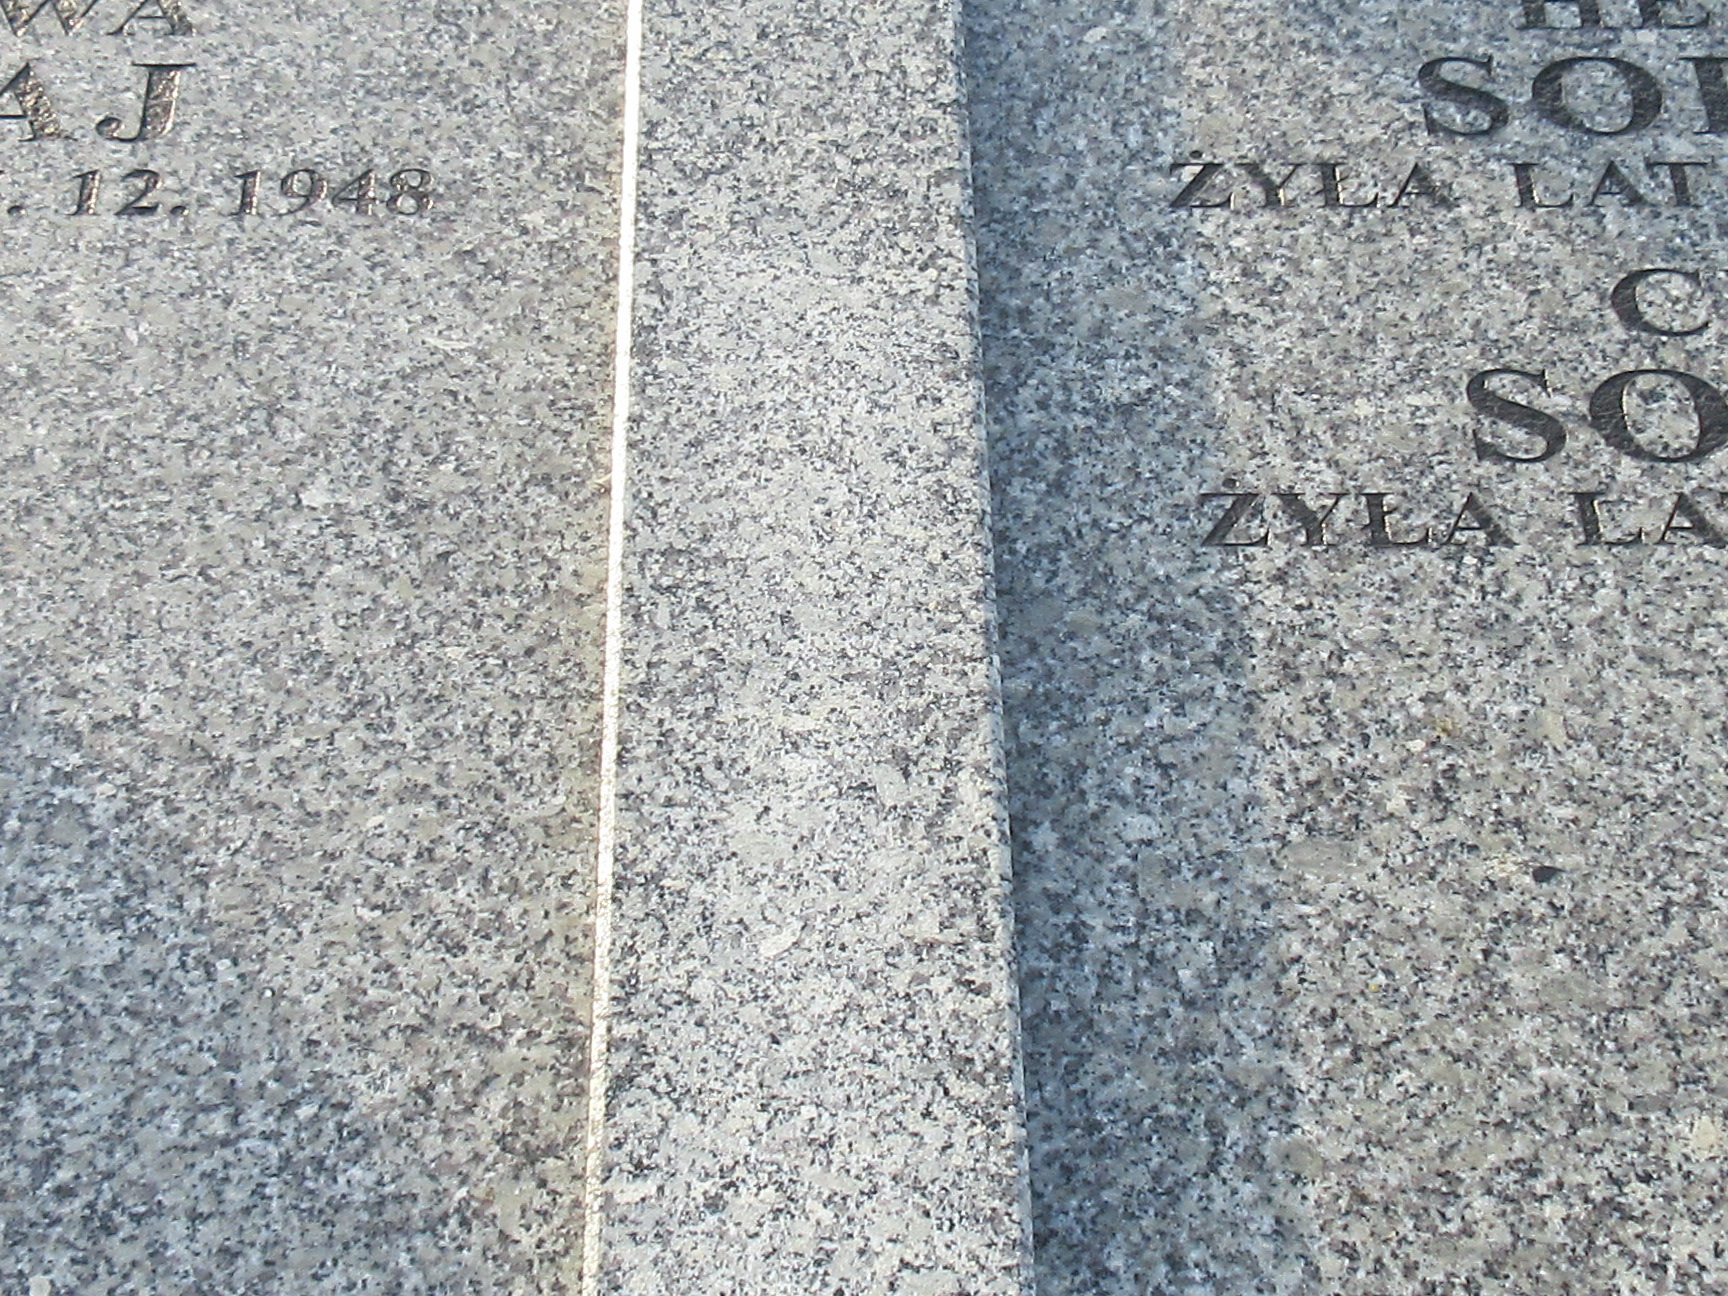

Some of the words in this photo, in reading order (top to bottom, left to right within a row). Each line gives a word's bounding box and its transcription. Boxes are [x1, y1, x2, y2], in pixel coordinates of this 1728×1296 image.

[1168, 149, 1455, 210] ŻYŁA
[1512, 160, 1710, 208] LAT
[1199, 477, 1516, 549] ŻYŁA
